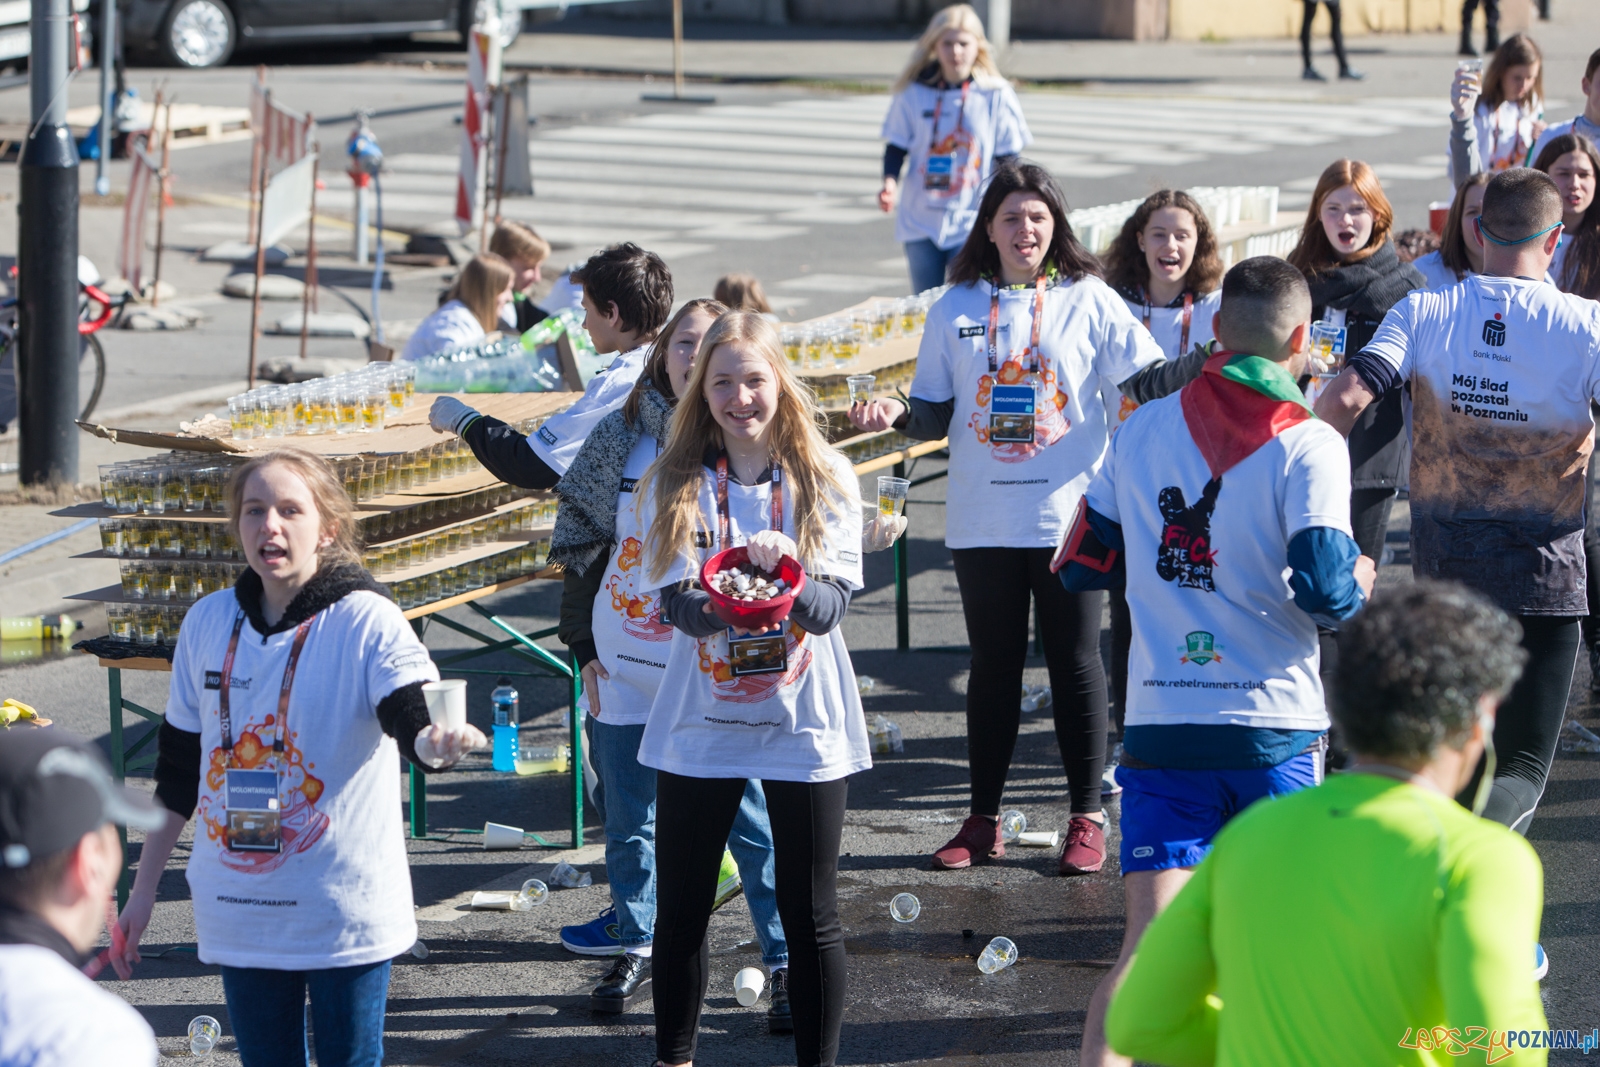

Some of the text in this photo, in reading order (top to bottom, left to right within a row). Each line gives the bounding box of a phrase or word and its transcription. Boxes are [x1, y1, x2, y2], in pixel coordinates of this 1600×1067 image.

[1473, 350, 1511, 362] Bank Polski
[1452, 373, 1508, 392] Mój ślad
[1451, 390, 1509, 406] pozostał
[1451, 404, 1528, 421] w Poznaniu
[616, 653, 666, 669] #POZNANPOLMAR
[1142, 679, 1267, 690] www.rebelrunners.club
[229, 786, 276, 795] WOLONTARIUSZ
